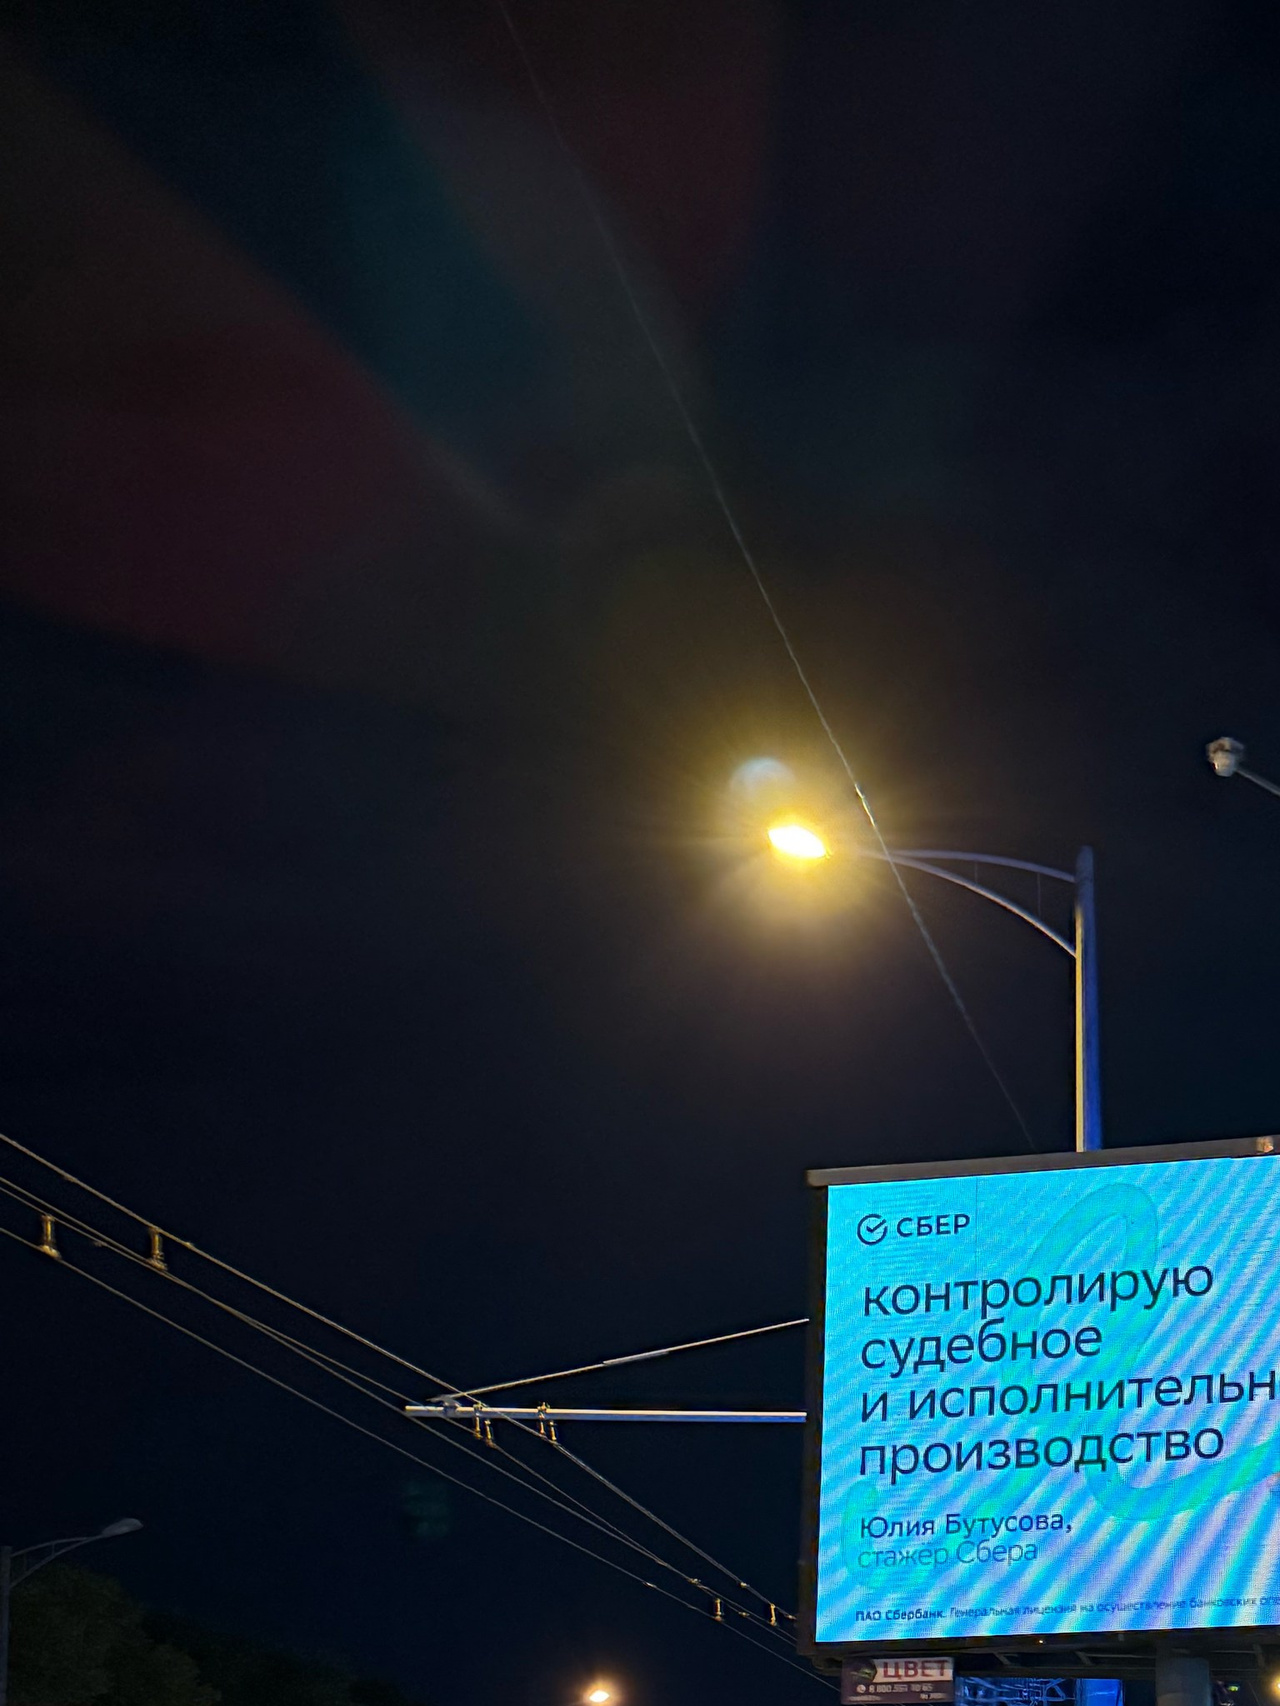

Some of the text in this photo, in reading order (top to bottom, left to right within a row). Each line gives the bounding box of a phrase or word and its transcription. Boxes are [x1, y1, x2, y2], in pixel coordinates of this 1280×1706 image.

[895, 1213, 970, 1239] СБЕР
[863, 1264, 1213, 1319] контролирую
[861, 1318, 1102, 1377] судебное
[861, 1389, 888, 1422] и
[859, 1427, 1224, 1485] производство
[860, 1510, 1073, 1540] Юлия Бутусова,
[955, 1538, 1038, 1566] Сбера
[855, 1611, 882, 1622] ПАО
[882, 1659, 949, 1681] ЦВЕТ
